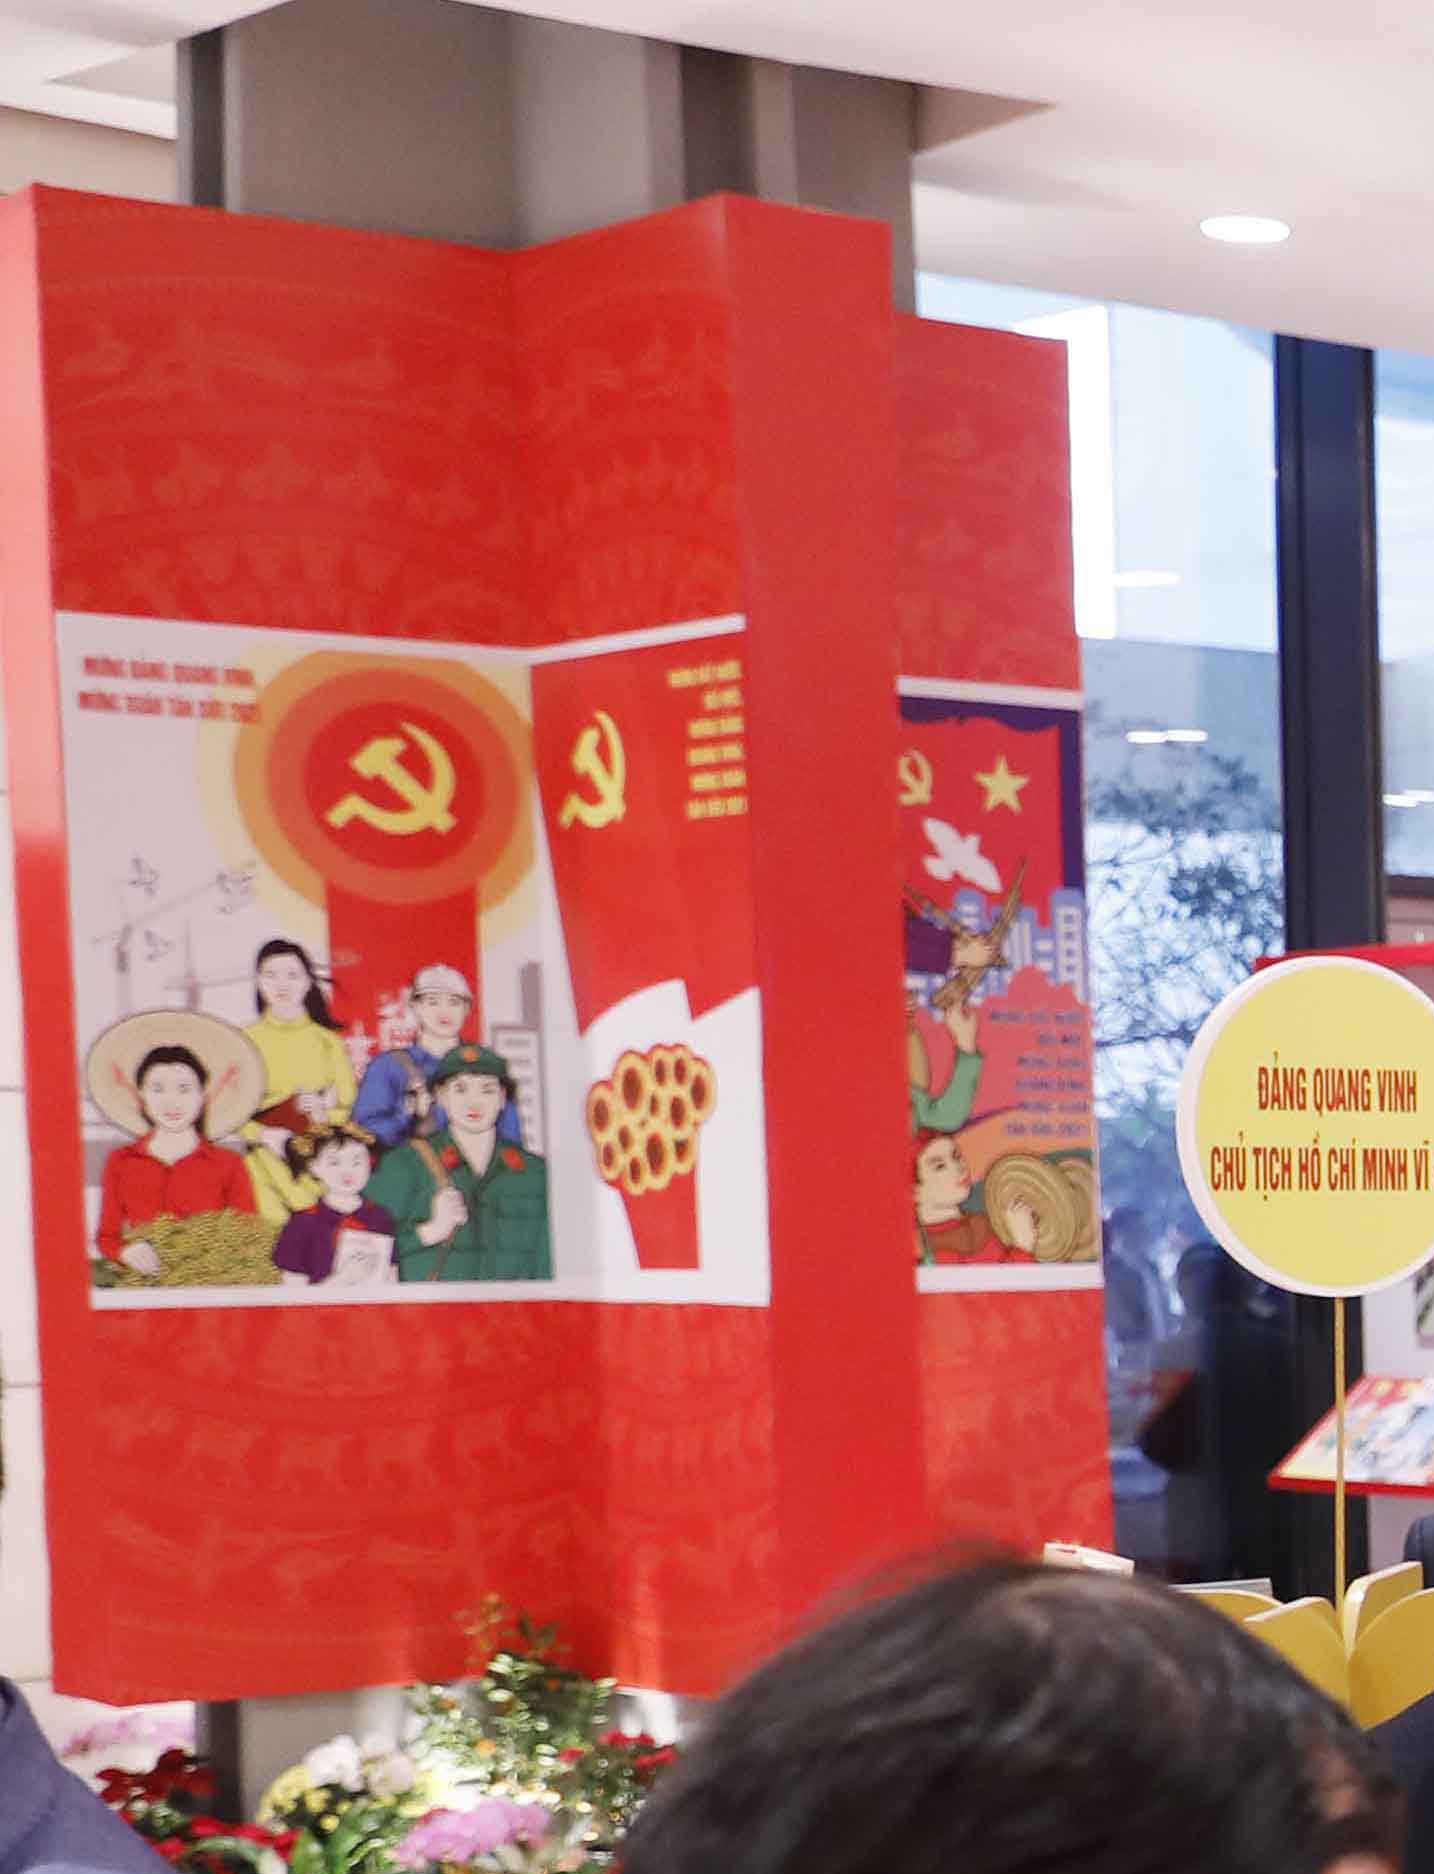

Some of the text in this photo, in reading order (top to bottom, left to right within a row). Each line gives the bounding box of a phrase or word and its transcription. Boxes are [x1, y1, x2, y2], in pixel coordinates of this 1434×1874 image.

[1258, 1051, 1417, 1117] ĐẢNG QUANG VINH
[1211, 1131, 1246, 1191] CHỦ
[1253, 1148, 1292, 1200] TỊCH
[1299, 1132, 1320, 1190] HỒ
[1328, 1138, 1355, 1190] CHÍ
[1363, 1149, 1407, 1191] MINH
[1414, 1140, 1429, 1190] VĨ
